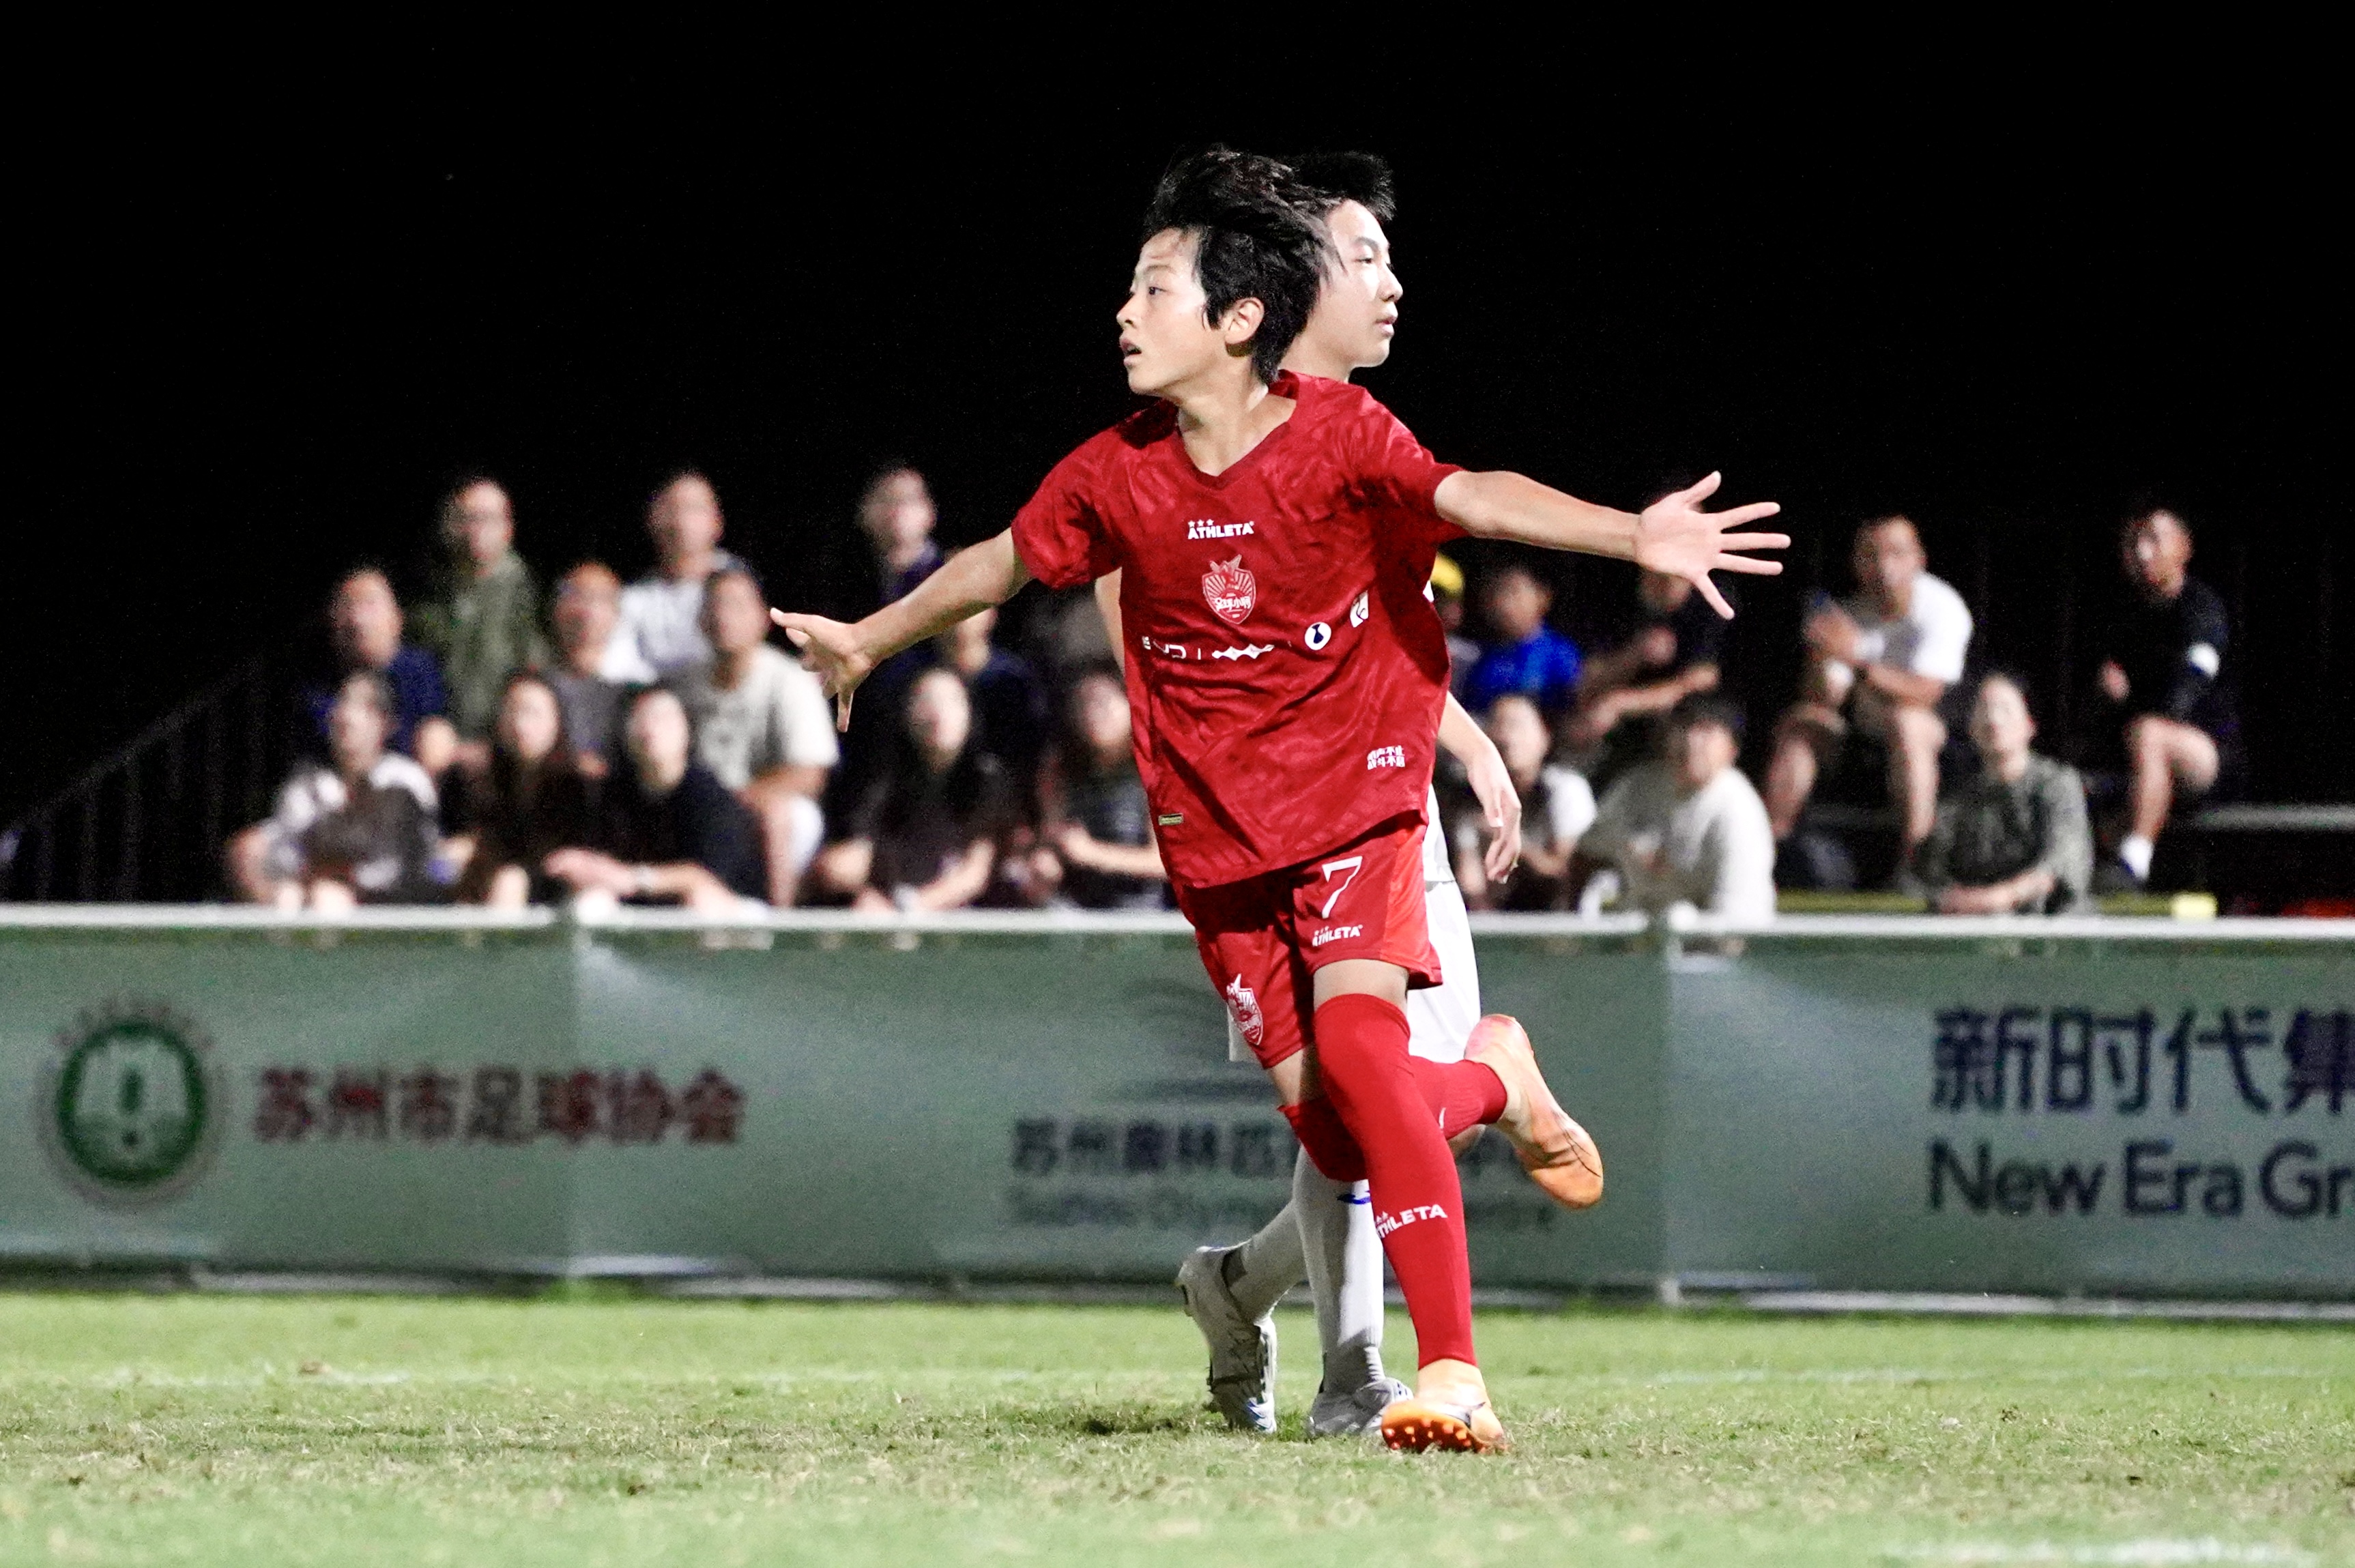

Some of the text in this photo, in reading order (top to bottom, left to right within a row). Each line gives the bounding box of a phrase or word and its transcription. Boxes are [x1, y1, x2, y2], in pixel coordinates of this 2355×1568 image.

[1187, 523, 1254, 539] ATHLETA
[1322, 856, 1363, 919] 7
[1933, 1006, 2355, 1115] 新时代集
[255, 1066, 746, 1145] 苏州市足球协会
[1928, 1138, 2355, 1219] New Era Gr
[1376, 1204, 1448, 1239] THLETA
